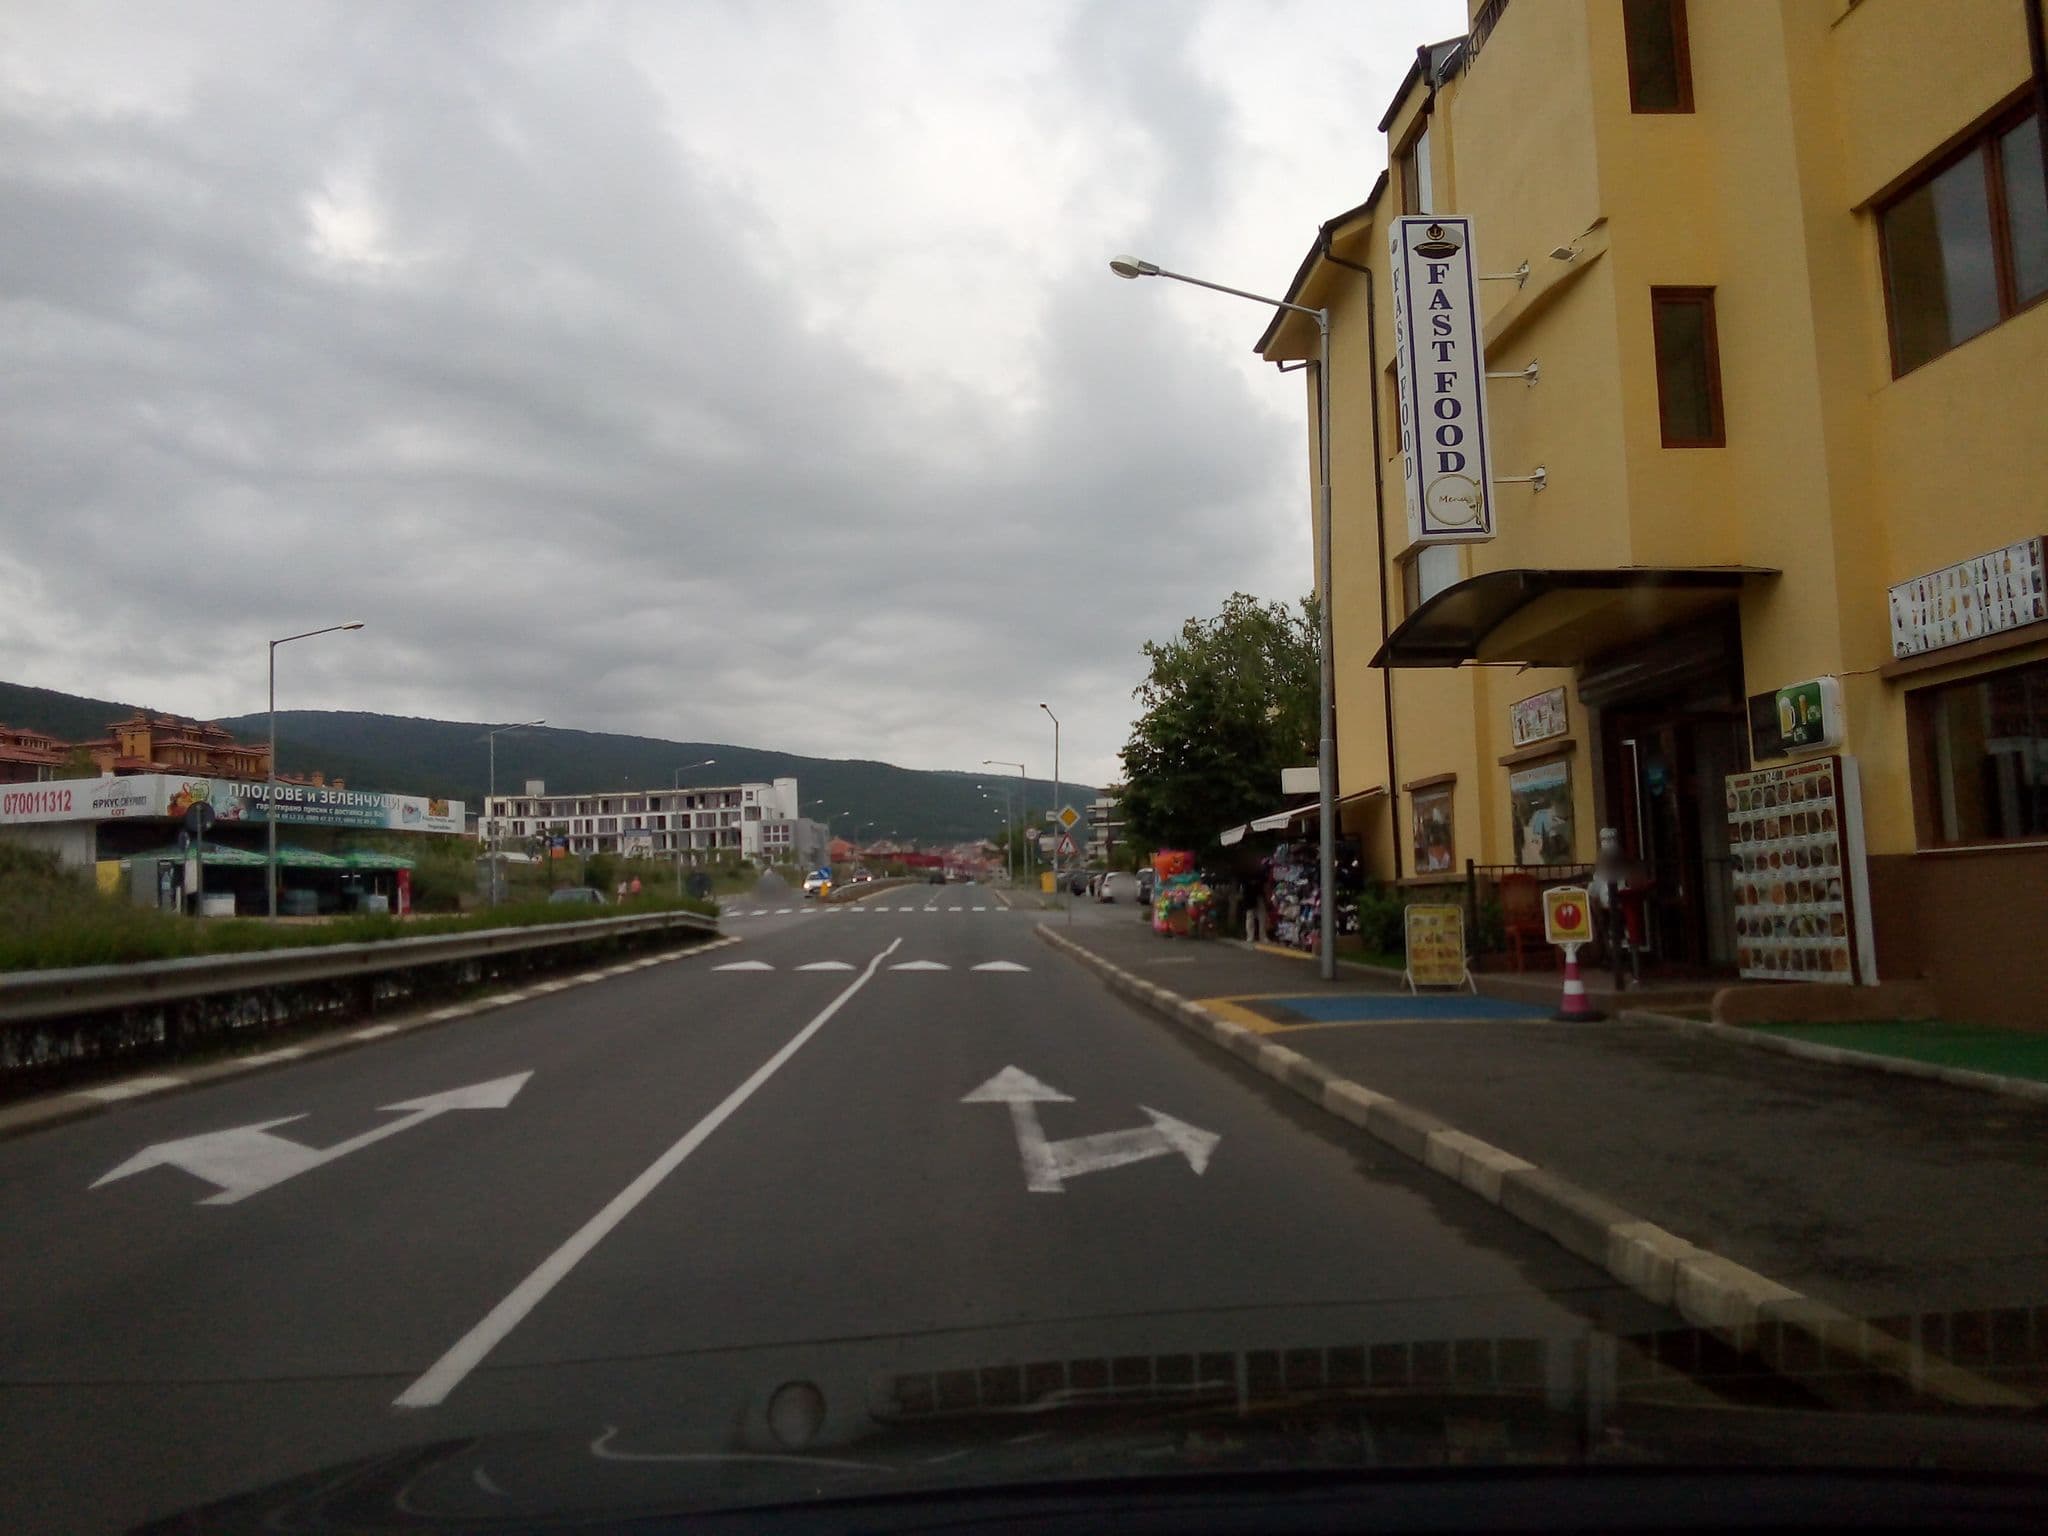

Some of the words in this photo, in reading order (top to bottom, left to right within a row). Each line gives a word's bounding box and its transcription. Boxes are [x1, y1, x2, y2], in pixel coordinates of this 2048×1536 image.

[1427, 263, 1456, 363] FAST
[1434, 371, 1466, 474] FOOD
[3, 790, 72, 815] 070011312
